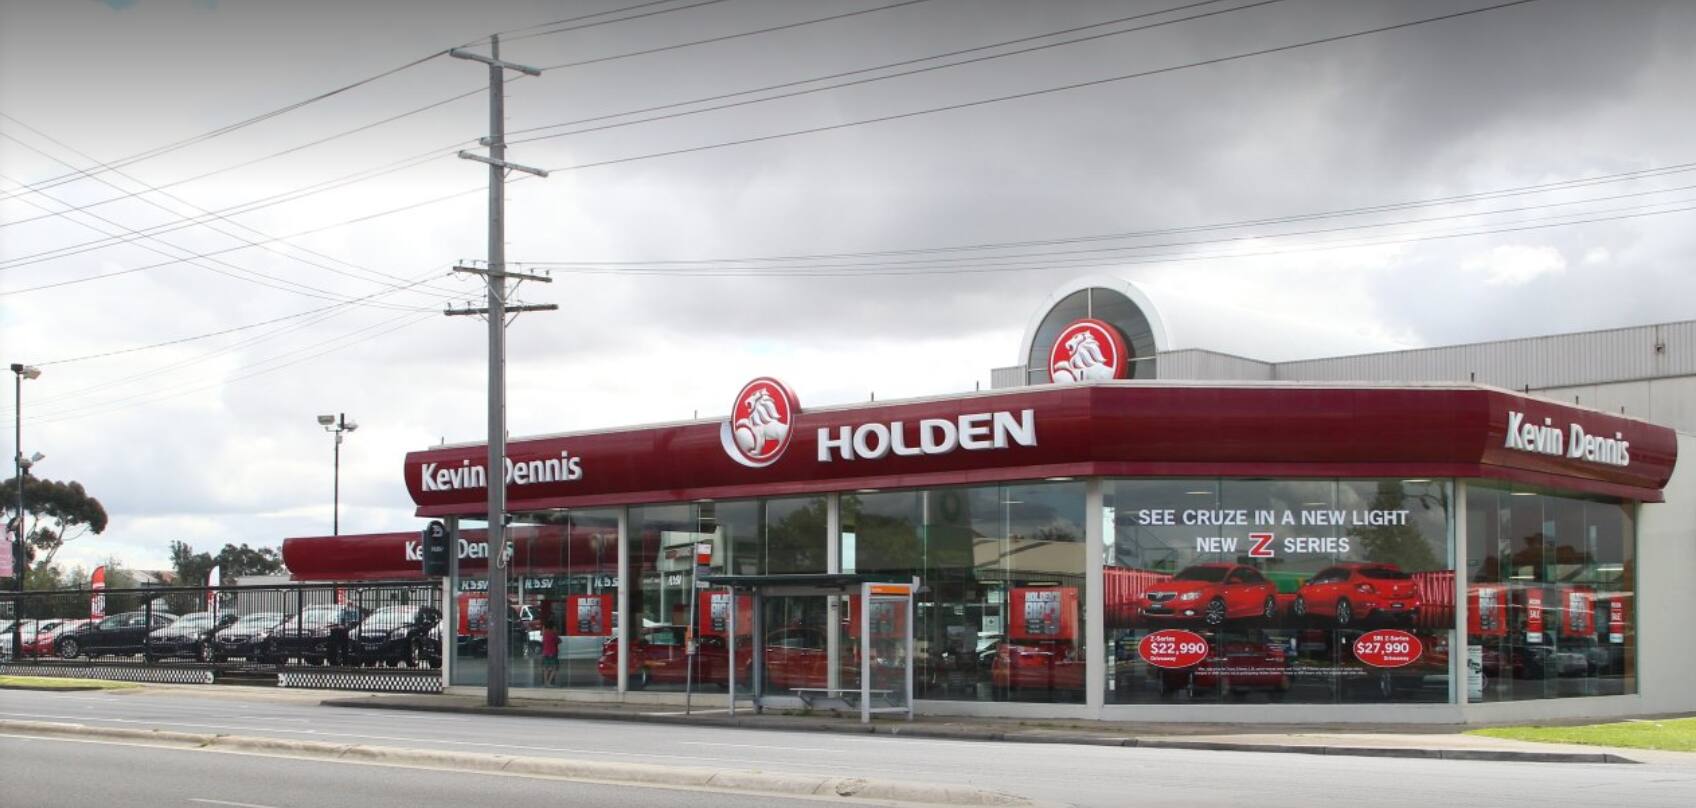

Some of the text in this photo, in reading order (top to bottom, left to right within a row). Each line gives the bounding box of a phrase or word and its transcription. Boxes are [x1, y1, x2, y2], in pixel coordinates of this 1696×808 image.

[817, 409, 1037, 462] HOLDEN
[1504, 410, 1630, 466] Kevin Dennis
[421, 459, 487, 491] Kevin
[1139, 509, 1409, 525] SEE CRUZE IN A NEW LIGHT
[1196, 532, 1350, 558] NEW Z SERIES
[1151, 642, 1205, 655] $22,990
[1357, 641, 1409, 656] $27,990
